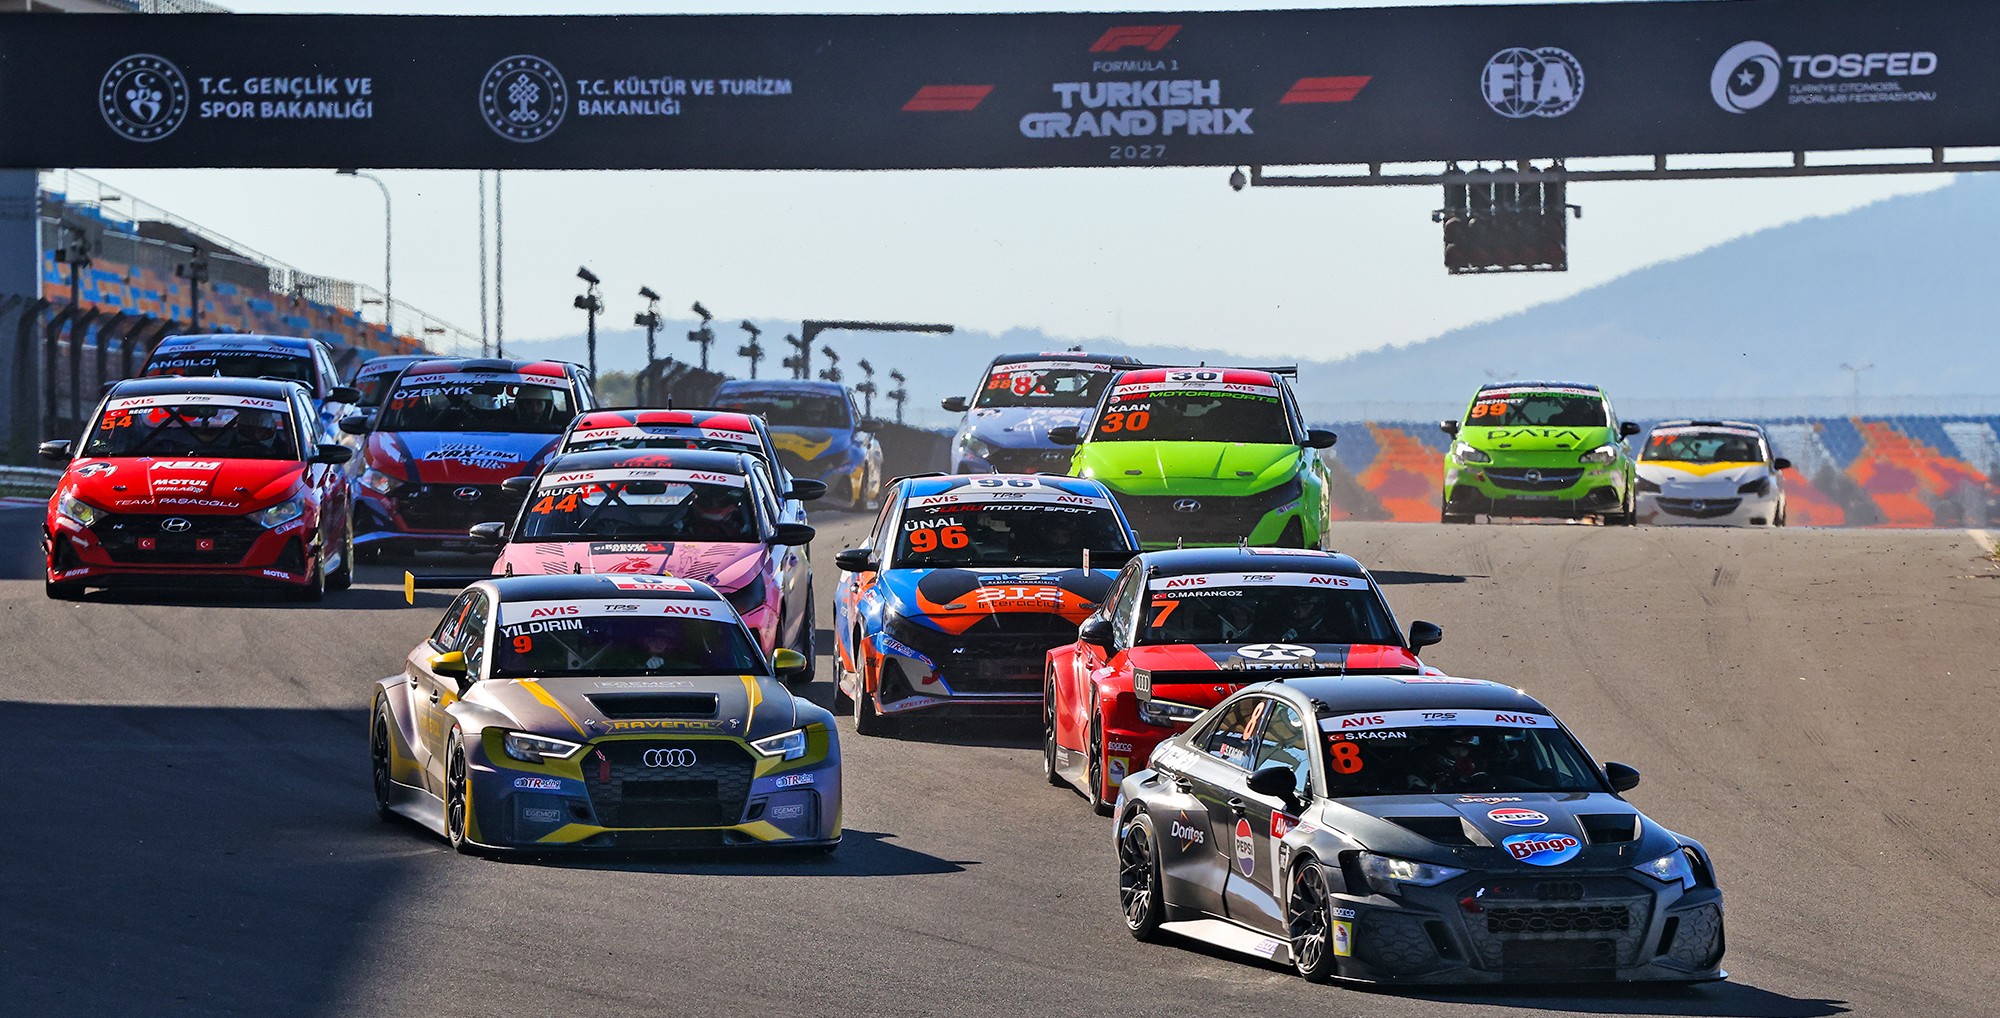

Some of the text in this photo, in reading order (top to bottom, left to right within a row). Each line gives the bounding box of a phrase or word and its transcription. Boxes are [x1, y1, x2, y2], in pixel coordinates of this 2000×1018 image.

[1093, 60, 1179, 72] FORMULA 1
[1787, 51, 1938, 79] TOSFED
[199, 73, 372, 99] T.C. GENÇLİK VE
[577, 76, 793, 96] T.C. KÜLTÜR VE TURİZM
[1053, 80, 1220, 108] TURKISH
[200, 98, 373, 119] SPOR BAKANLIĞI
[577, 97, 681, 116] BAKANLIĞI
[1020, 108, 1254, 138] GRAND PRIX
[1109, 145, 1166, 159] 2027
[1003, 363, 1028, 371] AVIS
[414, 375, 446, 383] AVIS
[525, 376, 557, 385] AVIS
[1172, 372, 1218, 381] 30
[987, 379, 1012, 390] 88
[1119, 385, 1150, 393] AVIS
[1223, 383, 1255, 392] AVIS
[121, 397, 154, 406] AVIS
[240, 399, 275, 407] AVIS
[1149, 391, 1278, 404] MOTORSPORTS
[1107, 403, 1151, 413] KAAN
[1471, 402, 1508, 418] 99
[101, 415, 133, 431] 54
[1101, 412, 1150, 433] 30
[584, 429, 619, 439] AVIS
[709, 431, 744, 441] AVIS
[1488, 428, 1581, 440] DATA
[557, 473, 596, 482] AVIS
[690, 473, 727, 482] AVIS
[977, 478, 1034, 488] 96
[537, 485, 596, 498] MURAT
[532, 494, 578, 515] 44
[922, 495, 960, 505] AVIS
[1056, 495, 1094, 505] AVIS
[904, 516, 963, 532] ÜNAL
[909, 526, 969, 553] 96
[65, 568, 290, 579] MOTUL MOTUL
[1166, 577, 1207, 588] AVIS
[1309, 576, 1350, 587] AVIS
[1167, 590, 1243, 599] O.MARANGOZ
[530, 606, 580, 618] AVIS
[663, 605, 712, 617] AVIS
[1151, 600, 1180, 628] 7
[501, 618, 583, 638] YILDIRIM
[512, 635, 532, 654] 9
[613, 720, 718, 730] RAVENOL
[1242, 701, 1265, 741] 8
[1341, 715, 1385, 728] AVIS
[1495, 714, 1537, 725] AVIS
[1345, 731, 1407, 743] S.KAÇAN
[1330, 741, 1364, 774] 8
[525, 806, 801, 817] EGEMOT EGEMOT
[1171, 820, 1204, 844] Doritos
[1236, 839, 1254, 856] PEPSI
[1508, 837, 1577, 860] Bingo
[1333, 906, 1356, 916] sparco
